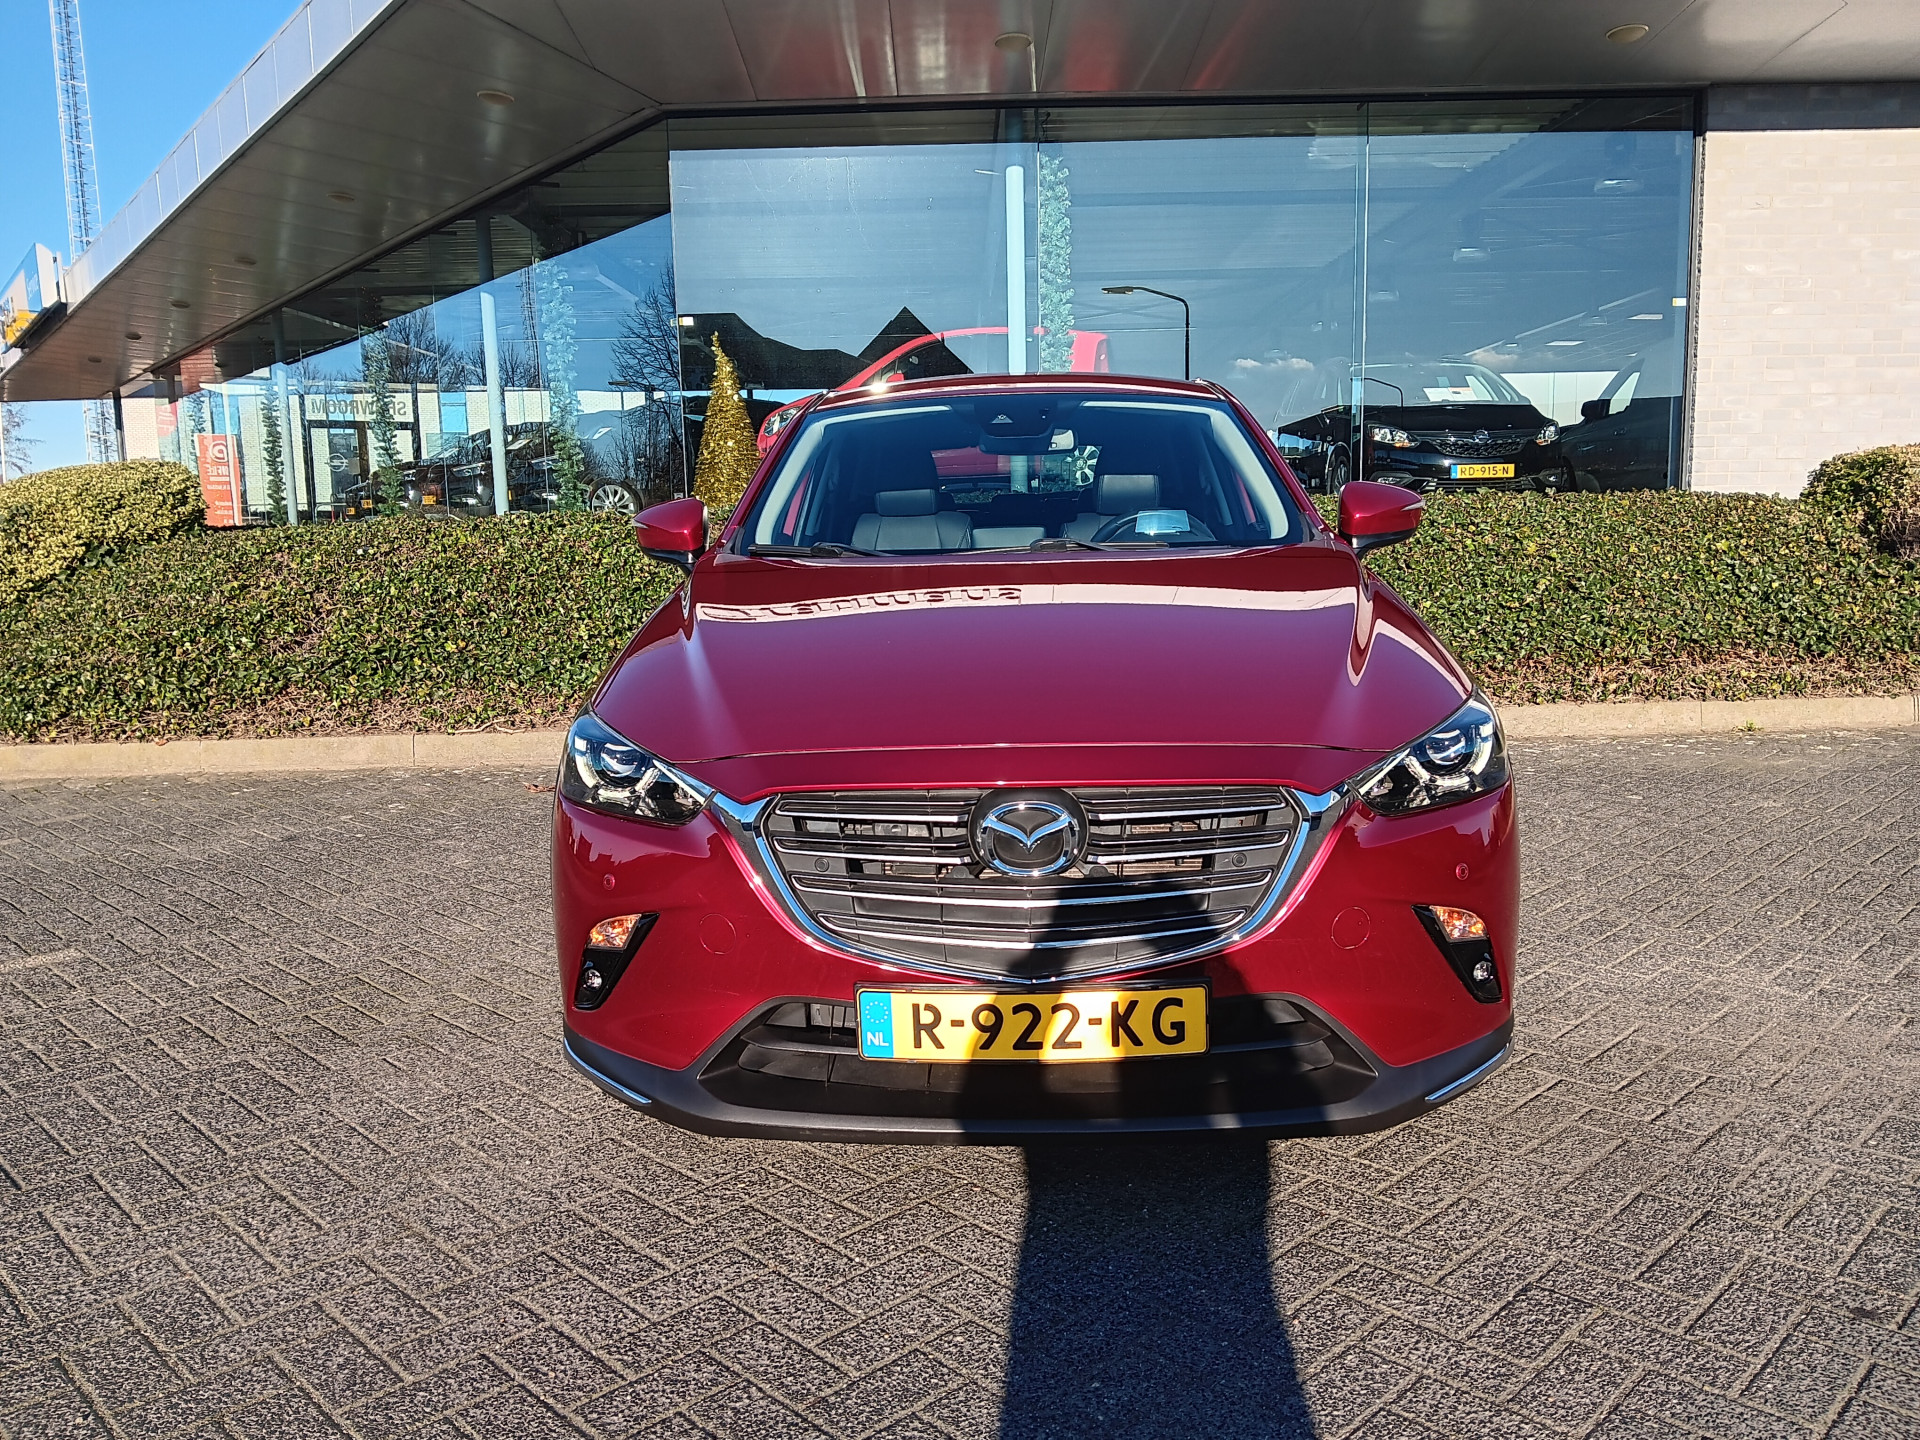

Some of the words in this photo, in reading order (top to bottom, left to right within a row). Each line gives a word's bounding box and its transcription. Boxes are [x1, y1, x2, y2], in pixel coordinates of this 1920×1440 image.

[1460, 466, 1509, 476] RD-915-N
[866, 1031, 889, 1047] NL
[911, 997, 1187, 1051] R-922-KG
